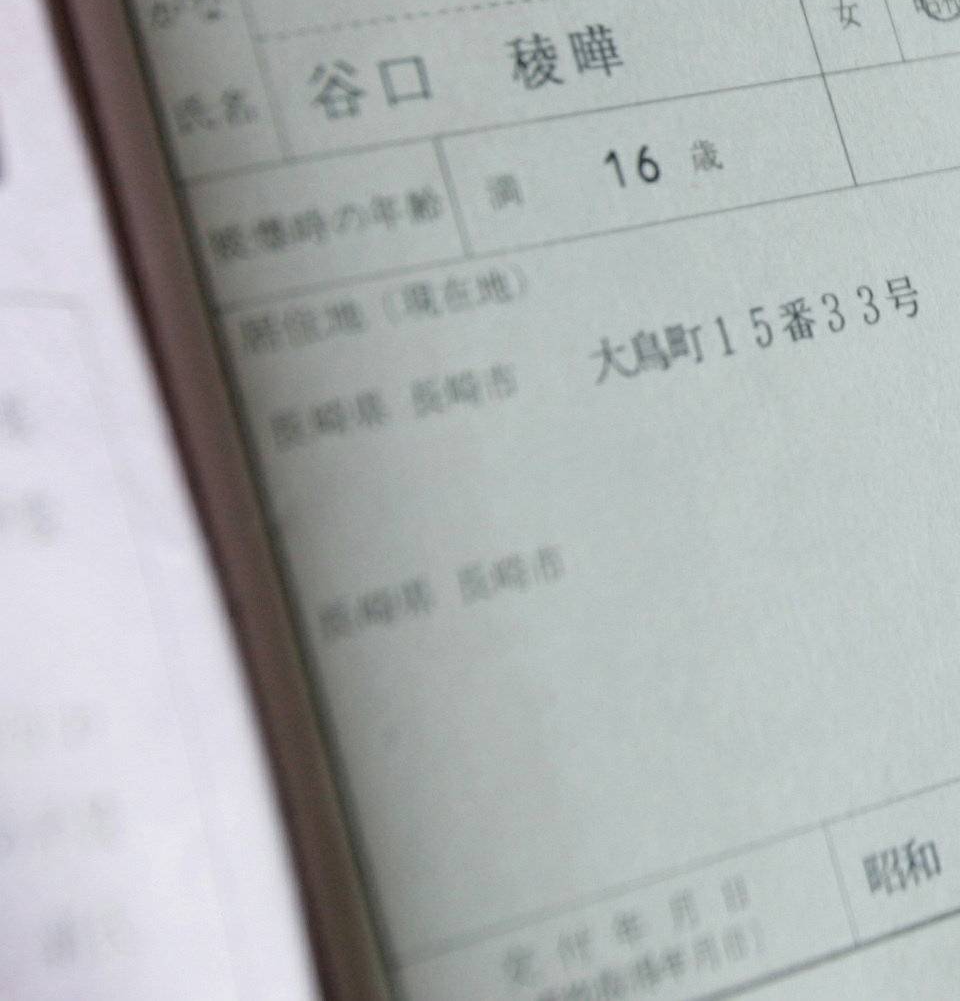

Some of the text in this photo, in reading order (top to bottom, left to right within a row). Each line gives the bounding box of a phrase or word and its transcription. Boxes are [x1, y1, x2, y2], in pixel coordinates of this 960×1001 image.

[307, 54, 436, 123] 谷口
[604, 144, 661, 189] 16
[861, 836, 942, 897] 昭和
